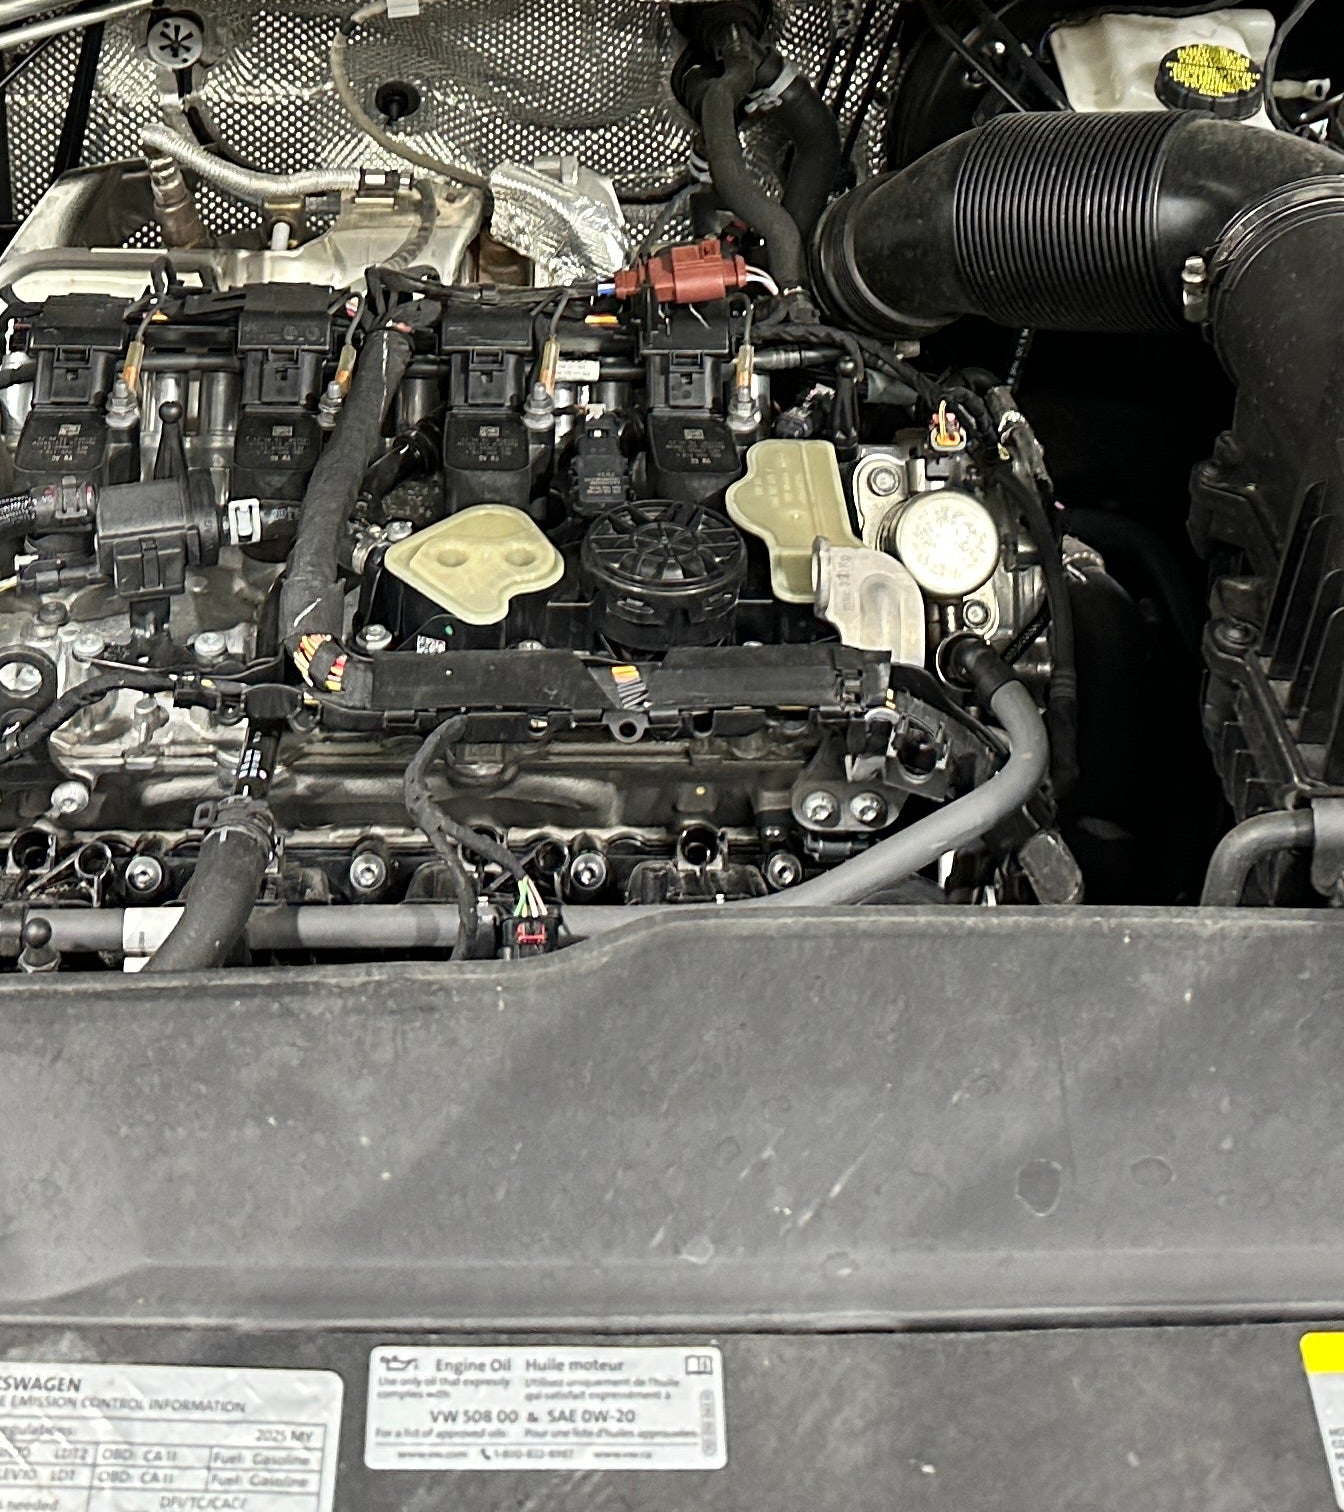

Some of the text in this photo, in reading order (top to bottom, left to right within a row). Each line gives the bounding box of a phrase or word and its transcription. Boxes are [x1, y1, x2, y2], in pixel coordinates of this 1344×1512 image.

[436, 1358, 512, 1376] Engine Oil
[526, 1358, 624, 1372] Huile moteur
[11, 1394, 76, 1409] EMISSION
[82, 1396, 144, 1410] CONTROL
[150, 1398, 246, 1413] INFORMATION
[430, 1410, 458, 1423] VW
[464, 1410, 492, 1423] 508
[497, 1410, 518, 1423] 00
[527, 1412, 538, 1422] &
[547, 1410, 576, 1423] SAE
[256, 1429, 287, 1442] 2025
[290, 1430, 313, 1442] MY
[253, 1453, 310, 1466] Gasoline
[250, 1475, 308, 1488] Gasoline
